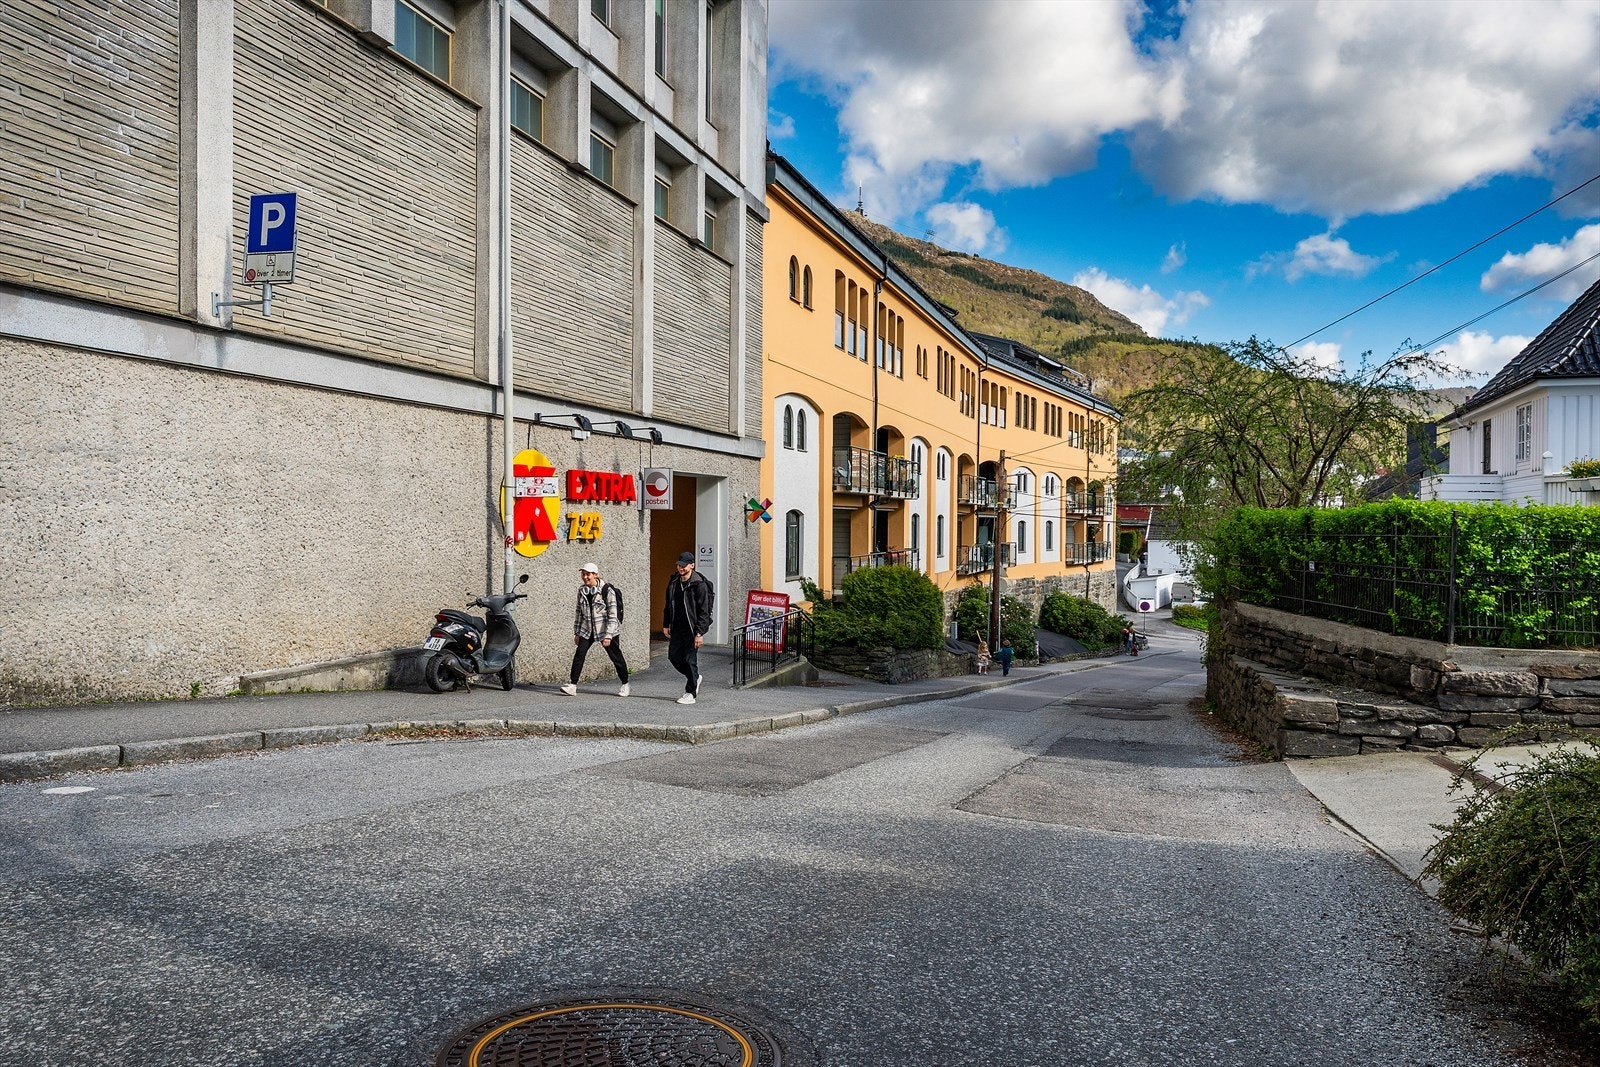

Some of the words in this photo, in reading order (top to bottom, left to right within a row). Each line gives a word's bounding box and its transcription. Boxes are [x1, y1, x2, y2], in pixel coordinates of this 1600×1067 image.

[260, 202, 286, 246] P
[277, 269, 292, 277] timer
[566, 469, 637, 502] EXTRA
[645, 498, 669, 506] posten
